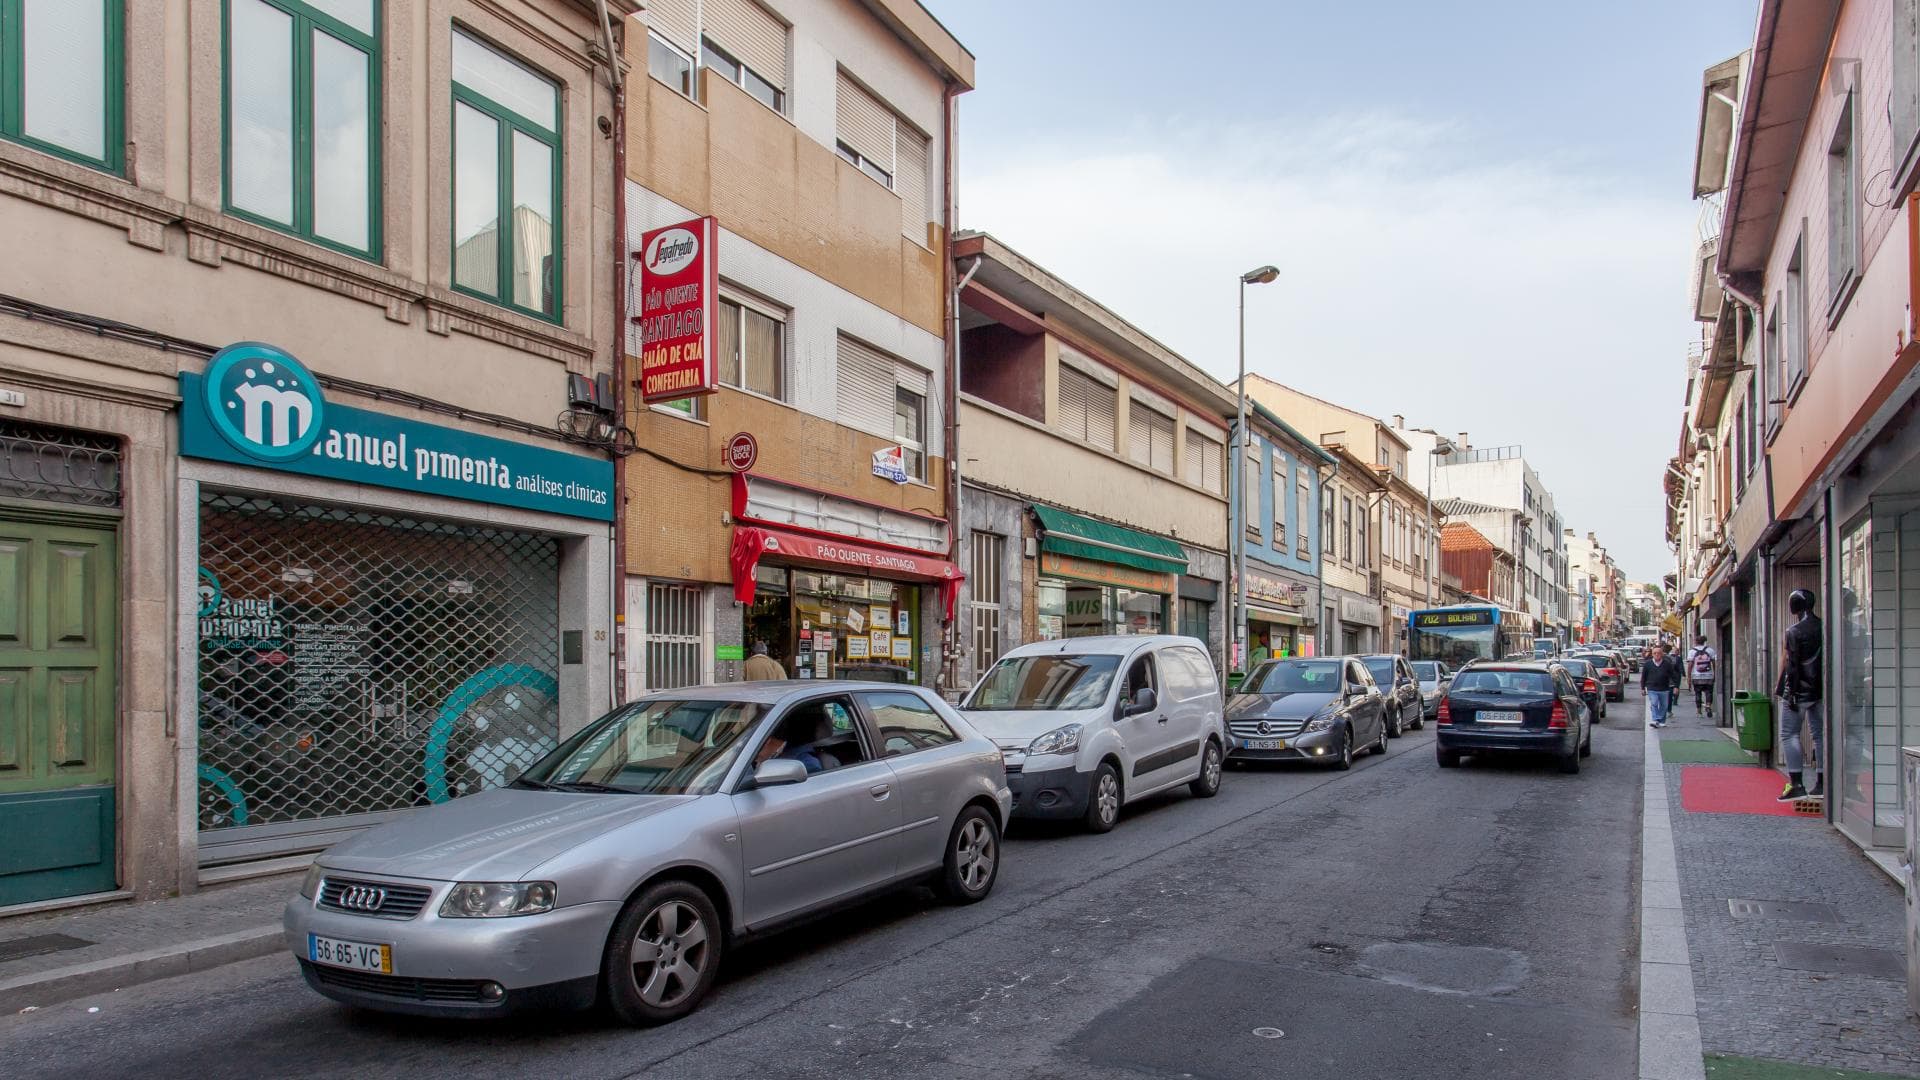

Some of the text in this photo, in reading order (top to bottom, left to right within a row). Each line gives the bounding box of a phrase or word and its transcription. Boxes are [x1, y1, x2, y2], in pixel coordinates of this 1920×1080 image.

[650, 236, 694, 268] Segafredo
[664, 283, 698, 311] QUENTE
[642, 308, 703, 344] SANTIAGO
[670, 345, 681, 365] DE
[684, 336, 703, 362] CHÁ
[646, 368, 700, 394] CONFEITARIA
[733, 444, 750, 453] SUPER
[734, 452, 750, 460] BOCK
[414, 447, 511, 489] pimenta
[516, 474, 563, 497] análises
[565, 481, 607, 505] clínicas
[838, 549, 872, 564] QUENTE
[875, 555, 915, 570] SANTIAGO
[1066, 599, 1100, 615] AVIS
[1424, 615, 1439, 624] 702
[594, 630, 606, 641] 33
[873, 631, 887, 641] Café
